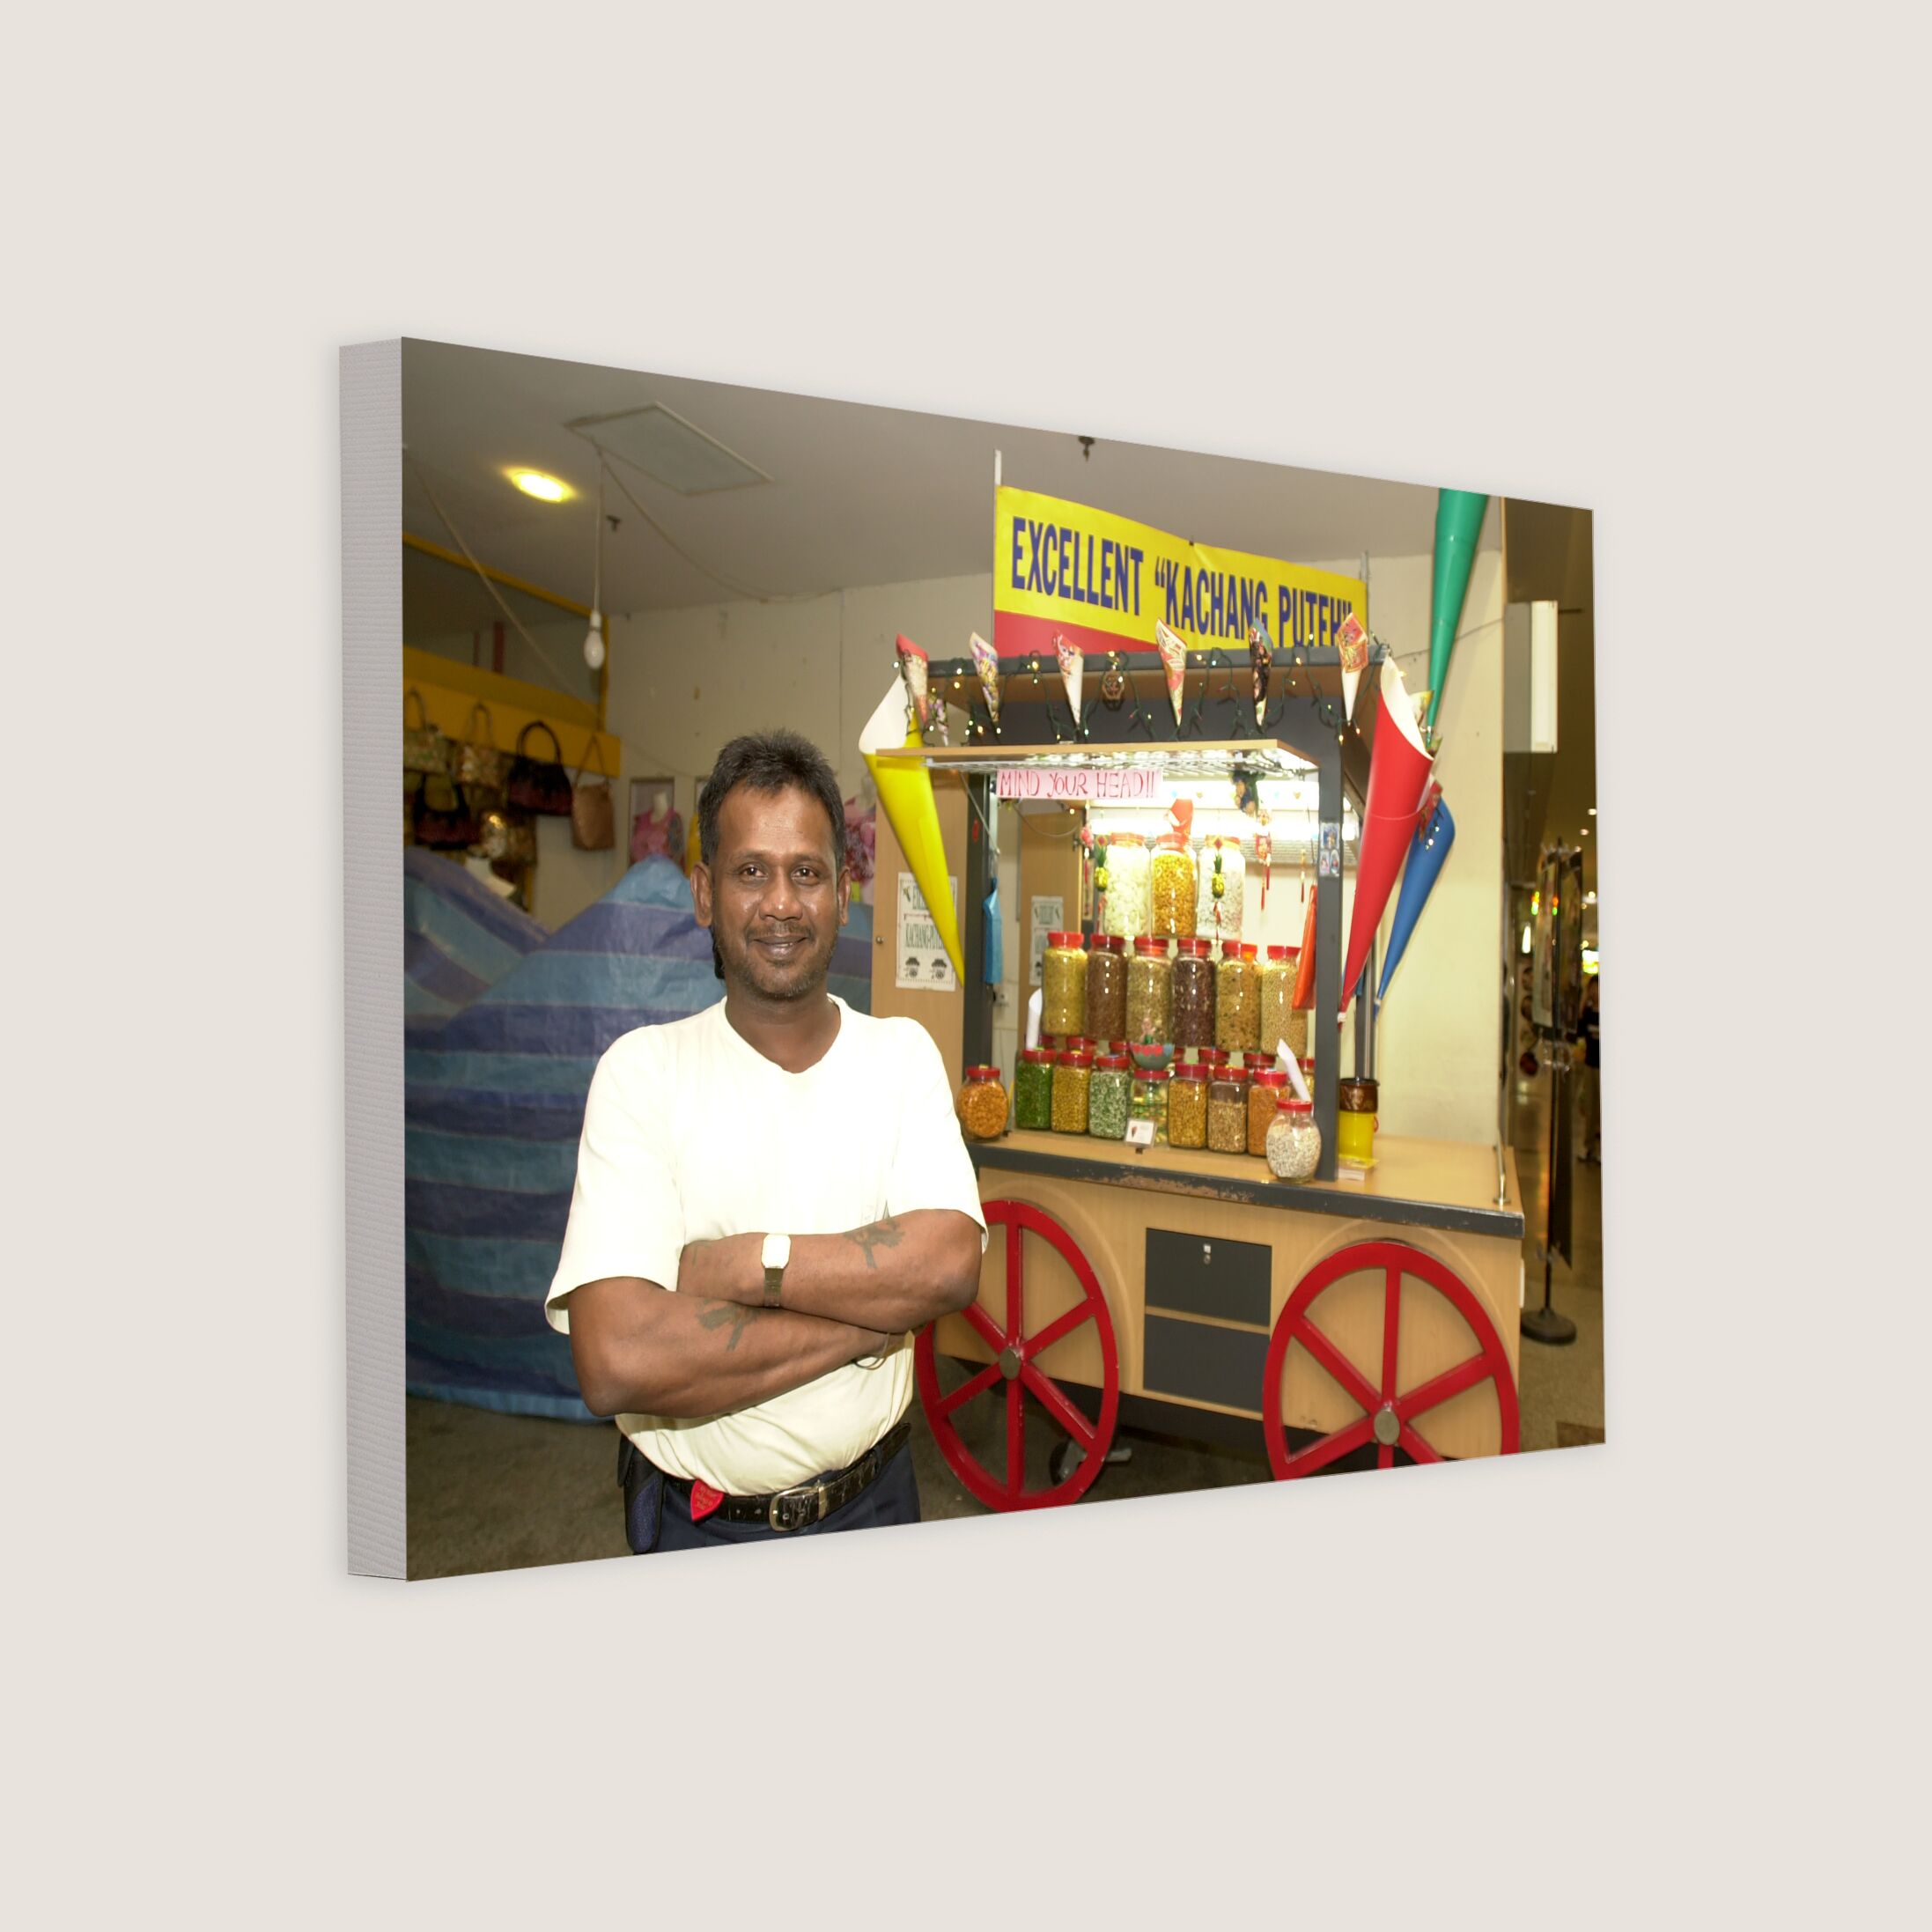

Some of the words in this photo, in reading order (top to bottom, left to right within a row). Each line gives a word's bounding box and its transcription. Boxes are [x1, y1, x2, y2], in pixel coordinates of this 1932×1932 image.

[1012, 516, 1144, 616] EXCELLENT
[1000, 771, 1040, 796] MIND
[1047, 772, 1088, 798] YOUR
[1096, 771, 1154, 798] HEAD!!
